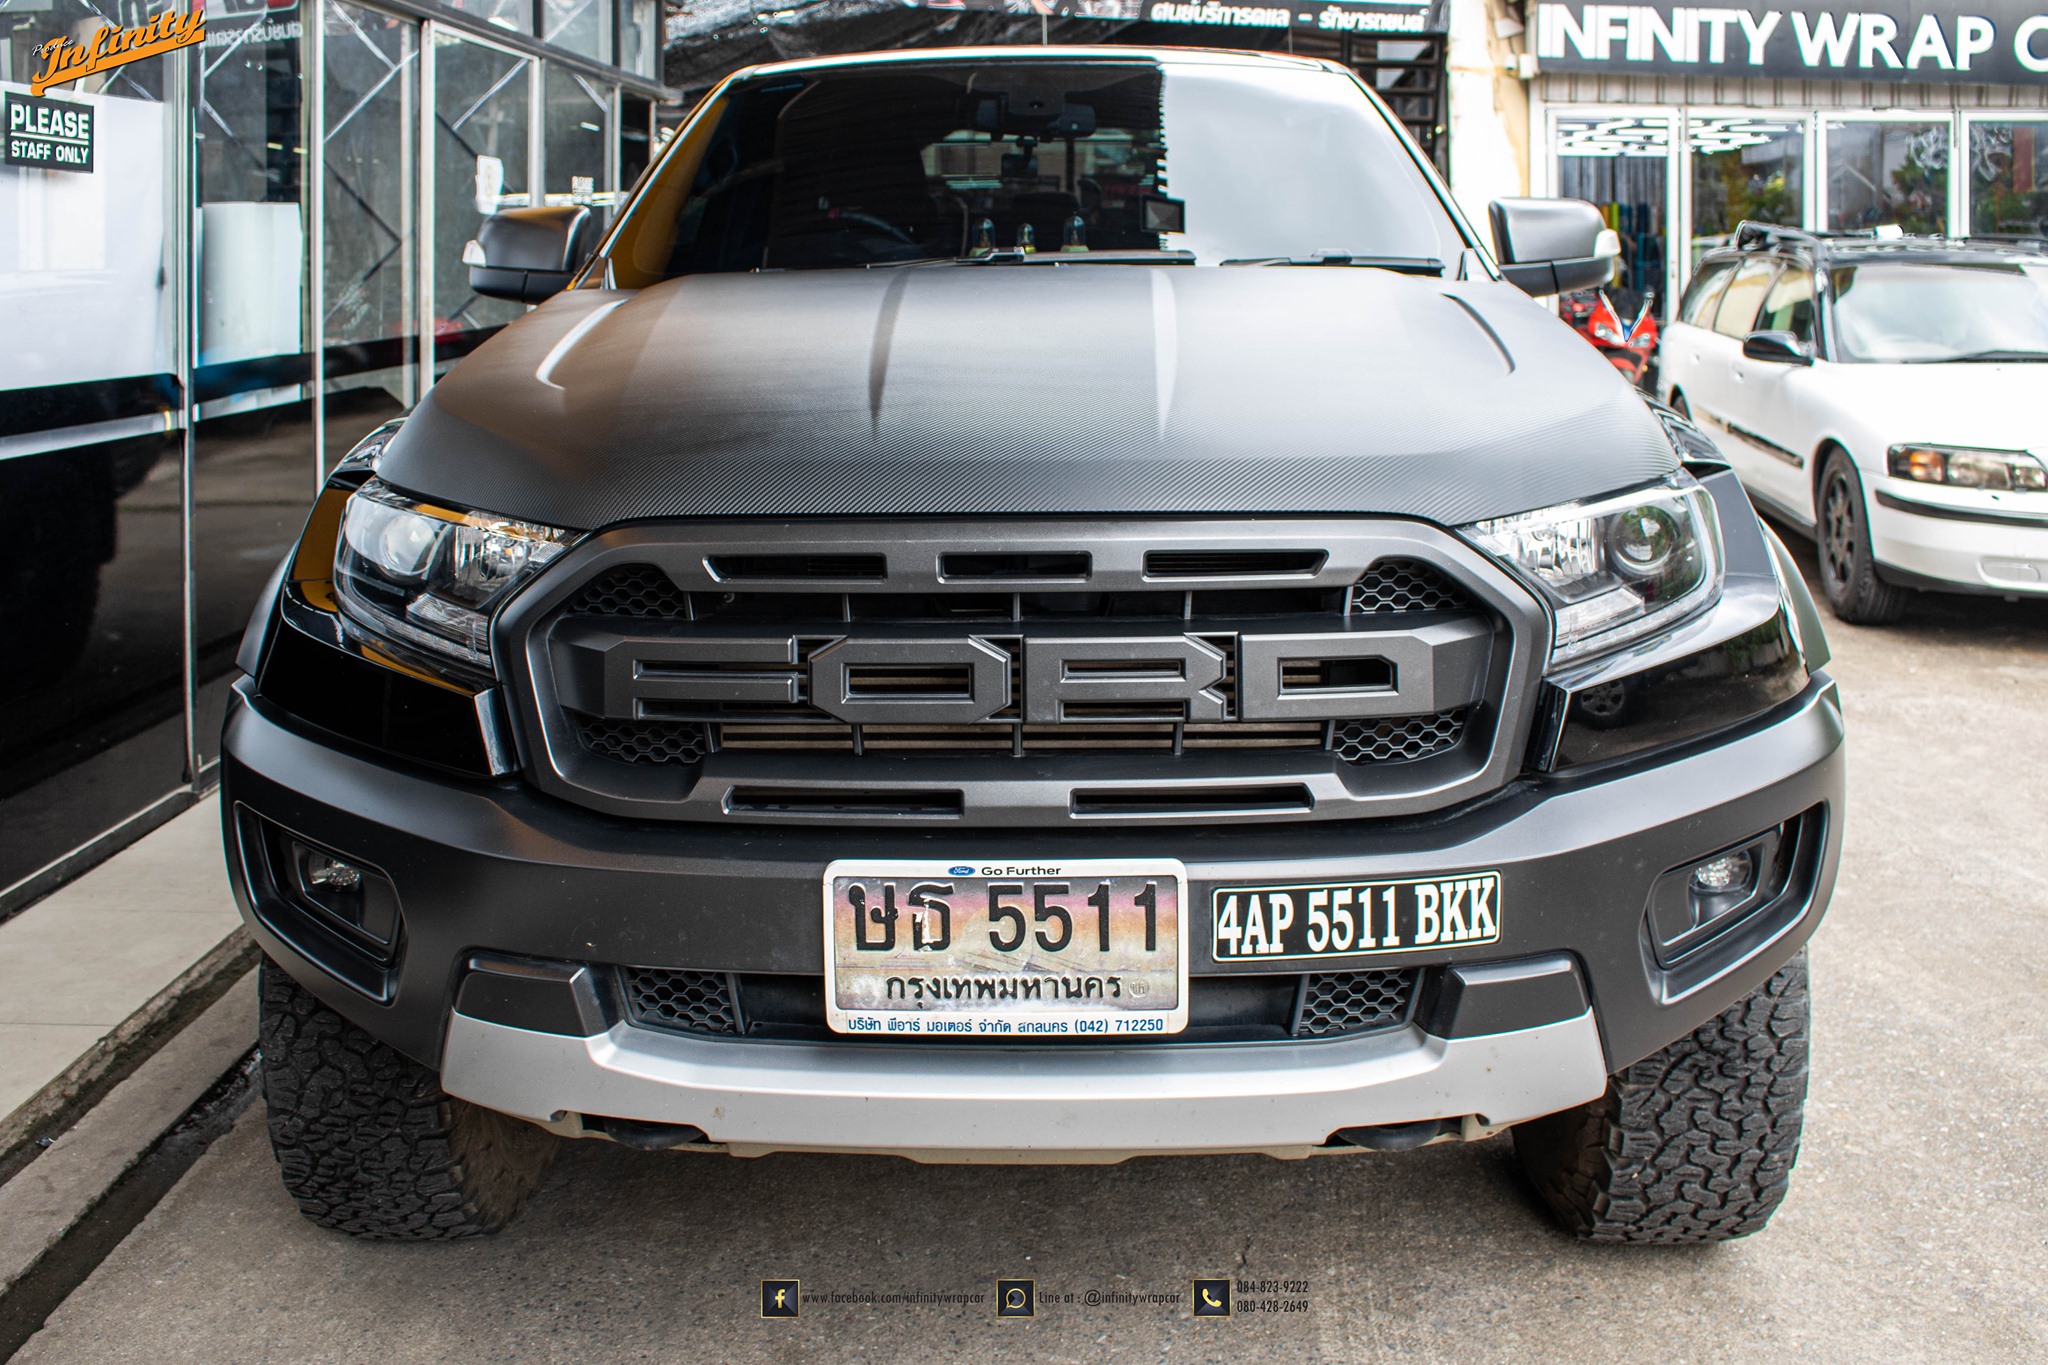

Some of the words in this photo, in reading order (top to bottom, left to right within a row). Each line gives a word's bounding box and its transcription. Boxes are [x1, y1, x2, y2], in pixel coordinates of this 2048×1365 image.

[1537, 2, 1784, 66] INFINITY
[1791, 11, 1997, 71] WRAP
[9, 103, 90, 140] PLEASE
[11, 141, 51, 161] STAFF
[55, 145, 89, 165] ONLY
[602, 633, 1434, 724] FORD
[981, 866, 1003, 876] Go
[1006, 866, 1062, 876] Further
[987, 881, 1158, 953] 5511
[1218, 892, 1294, 955] 4AP
[1307, 886, 1400, 952] 5511
[1414, 876, 1496, 945] BKK
[886, 974, 1122, 1009] กรุงเทพมหานคร
[848, 1016, 881, 1032] บริษัท
[926, 1018, 973, 1033] มอเตอร์
[979, 1018, 1012, 1034] จำกัด
[1074, 1018, 1109, 1034] (042)
[1115, 1018, 1164, 1033] 712250
